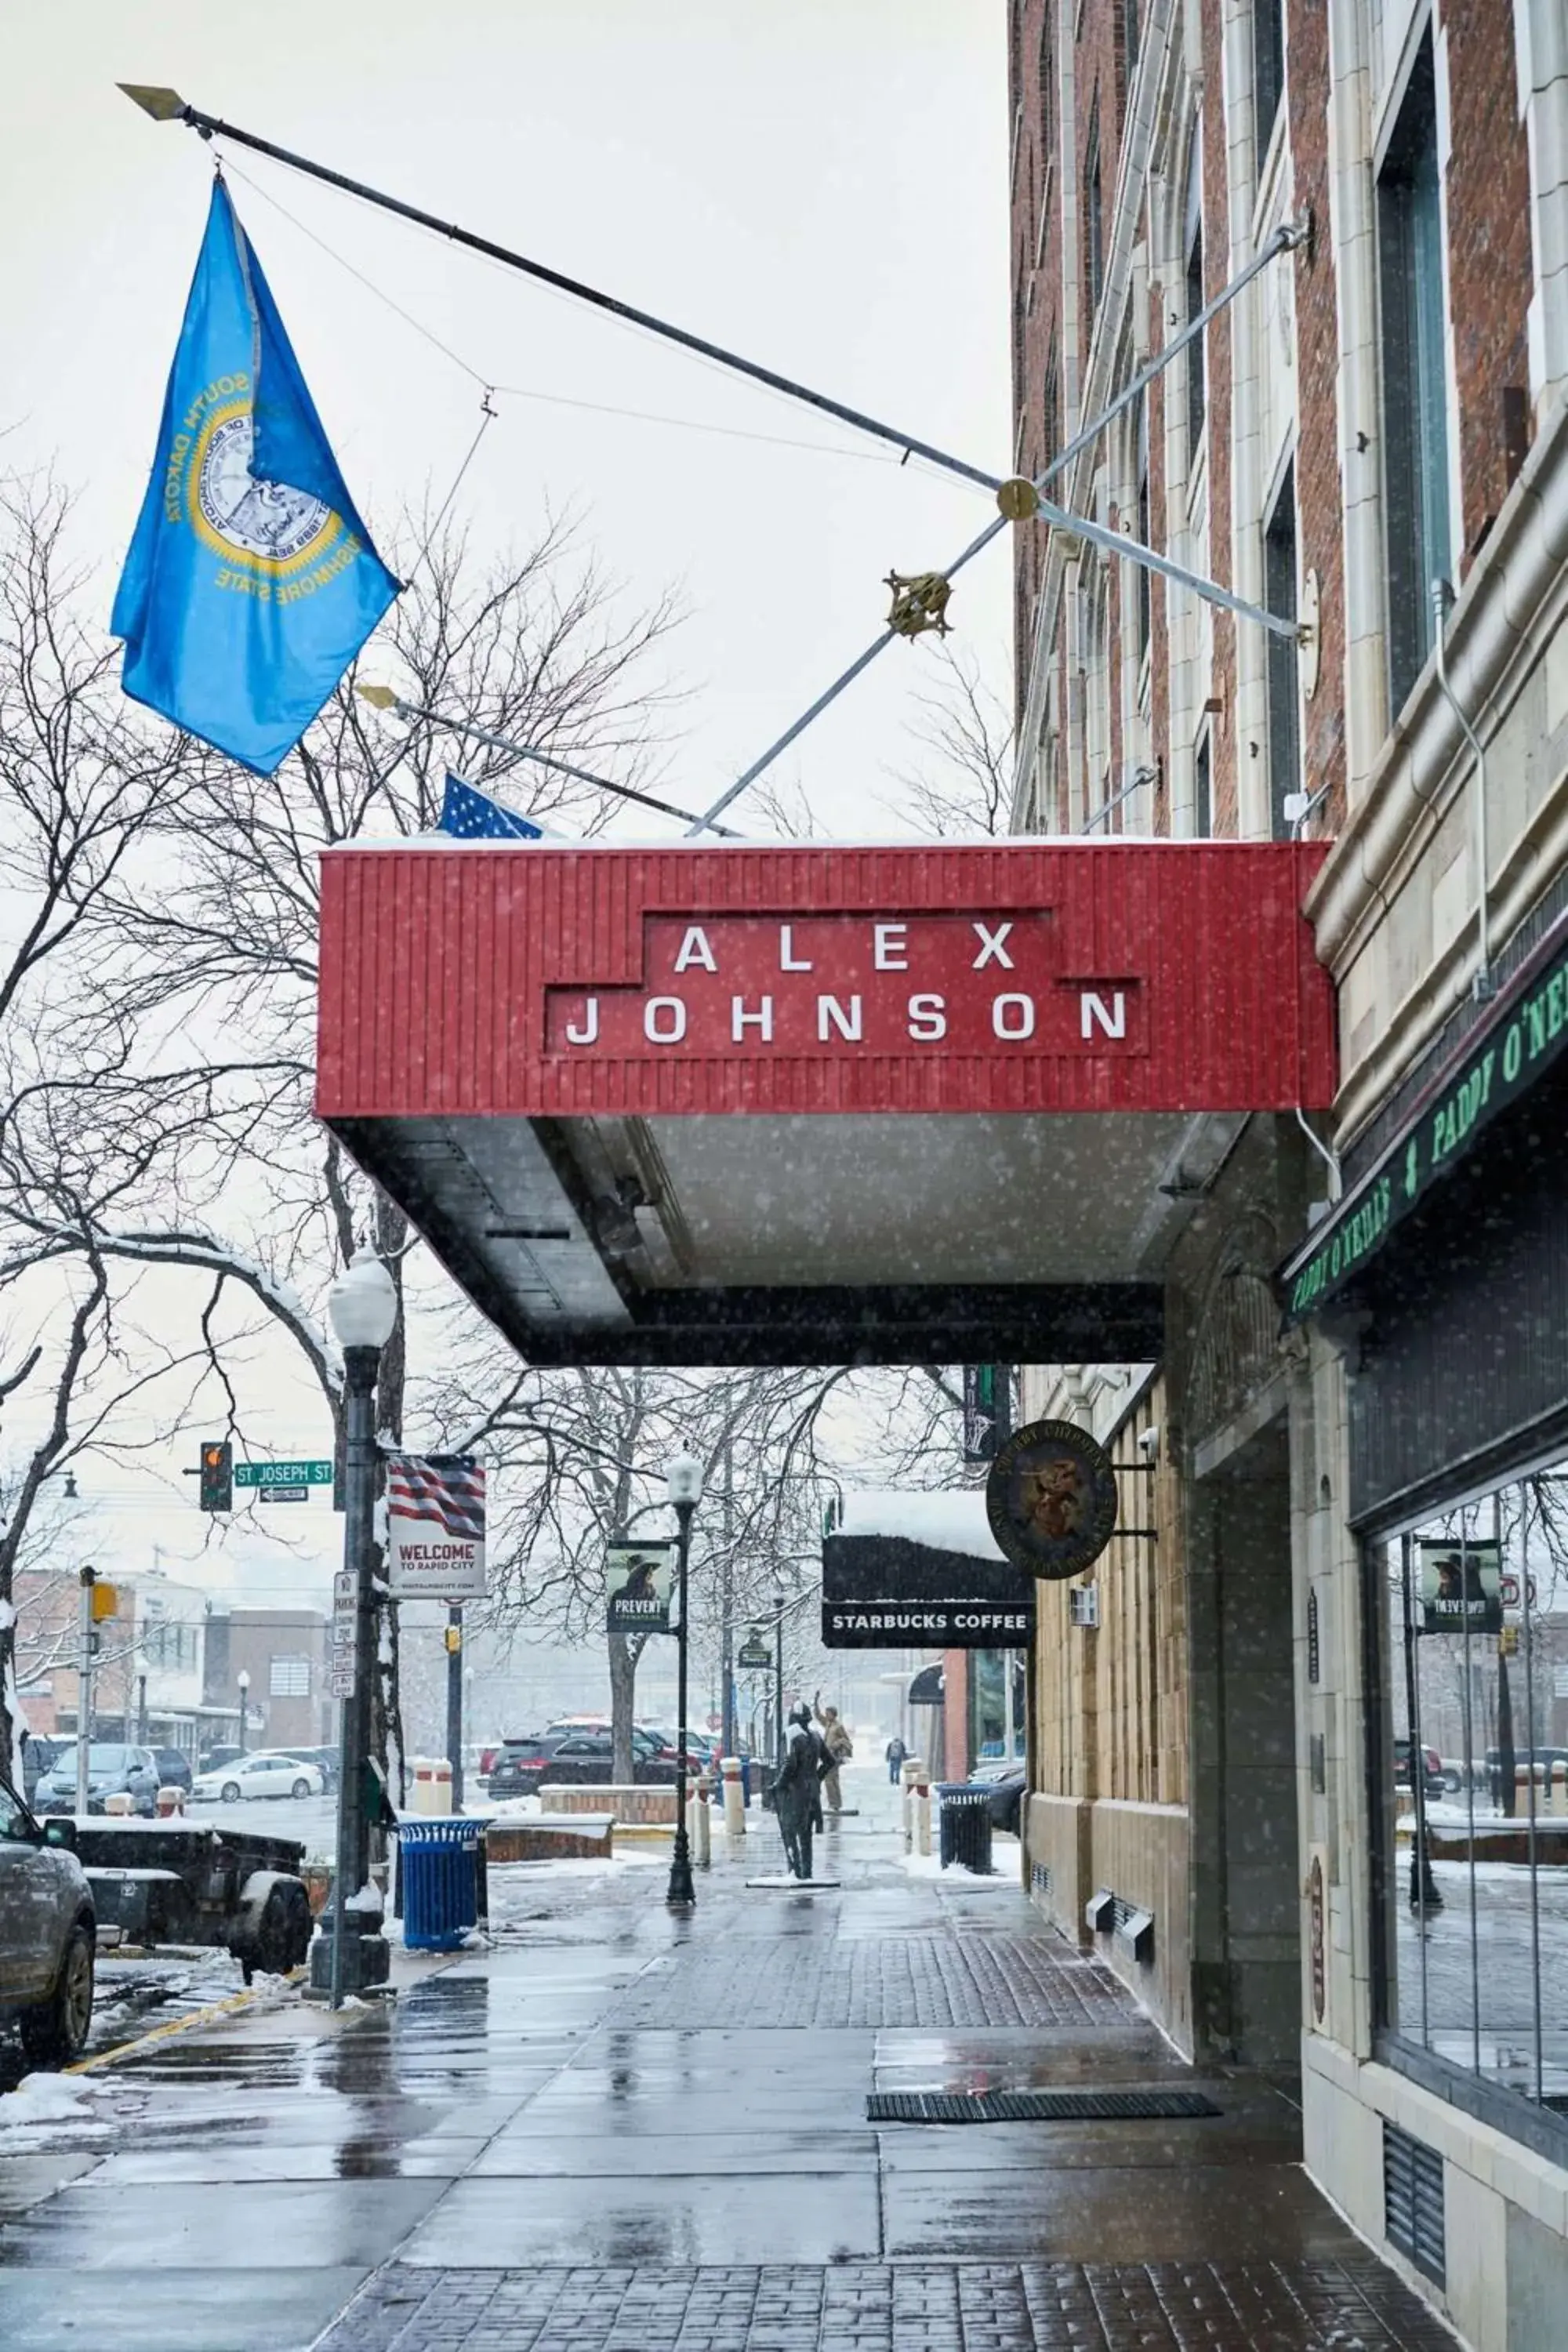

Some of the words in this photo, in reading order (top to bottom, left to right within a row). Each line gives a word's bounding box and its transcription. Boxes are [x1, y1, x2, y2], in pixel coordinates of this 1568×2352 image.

[673, 922, 1014, 974] ALEX
[565, 992, 1127, 1045] JOHNSON
[1432, 1048, 1495, 1165] PADDY
[238, 1467, 252, 1483] ST
[259, 1465, 308, 1483] JOSEPH
[314, 1465, 329, 1480] ST
[399, 1544, 474, 1560] WELCOME
[615, 1599, 661, 1613] PREVENT
[833, 1614, 947, 1629] STARBUCKS
[955, 1614, 1027, 1629] COFFEE
